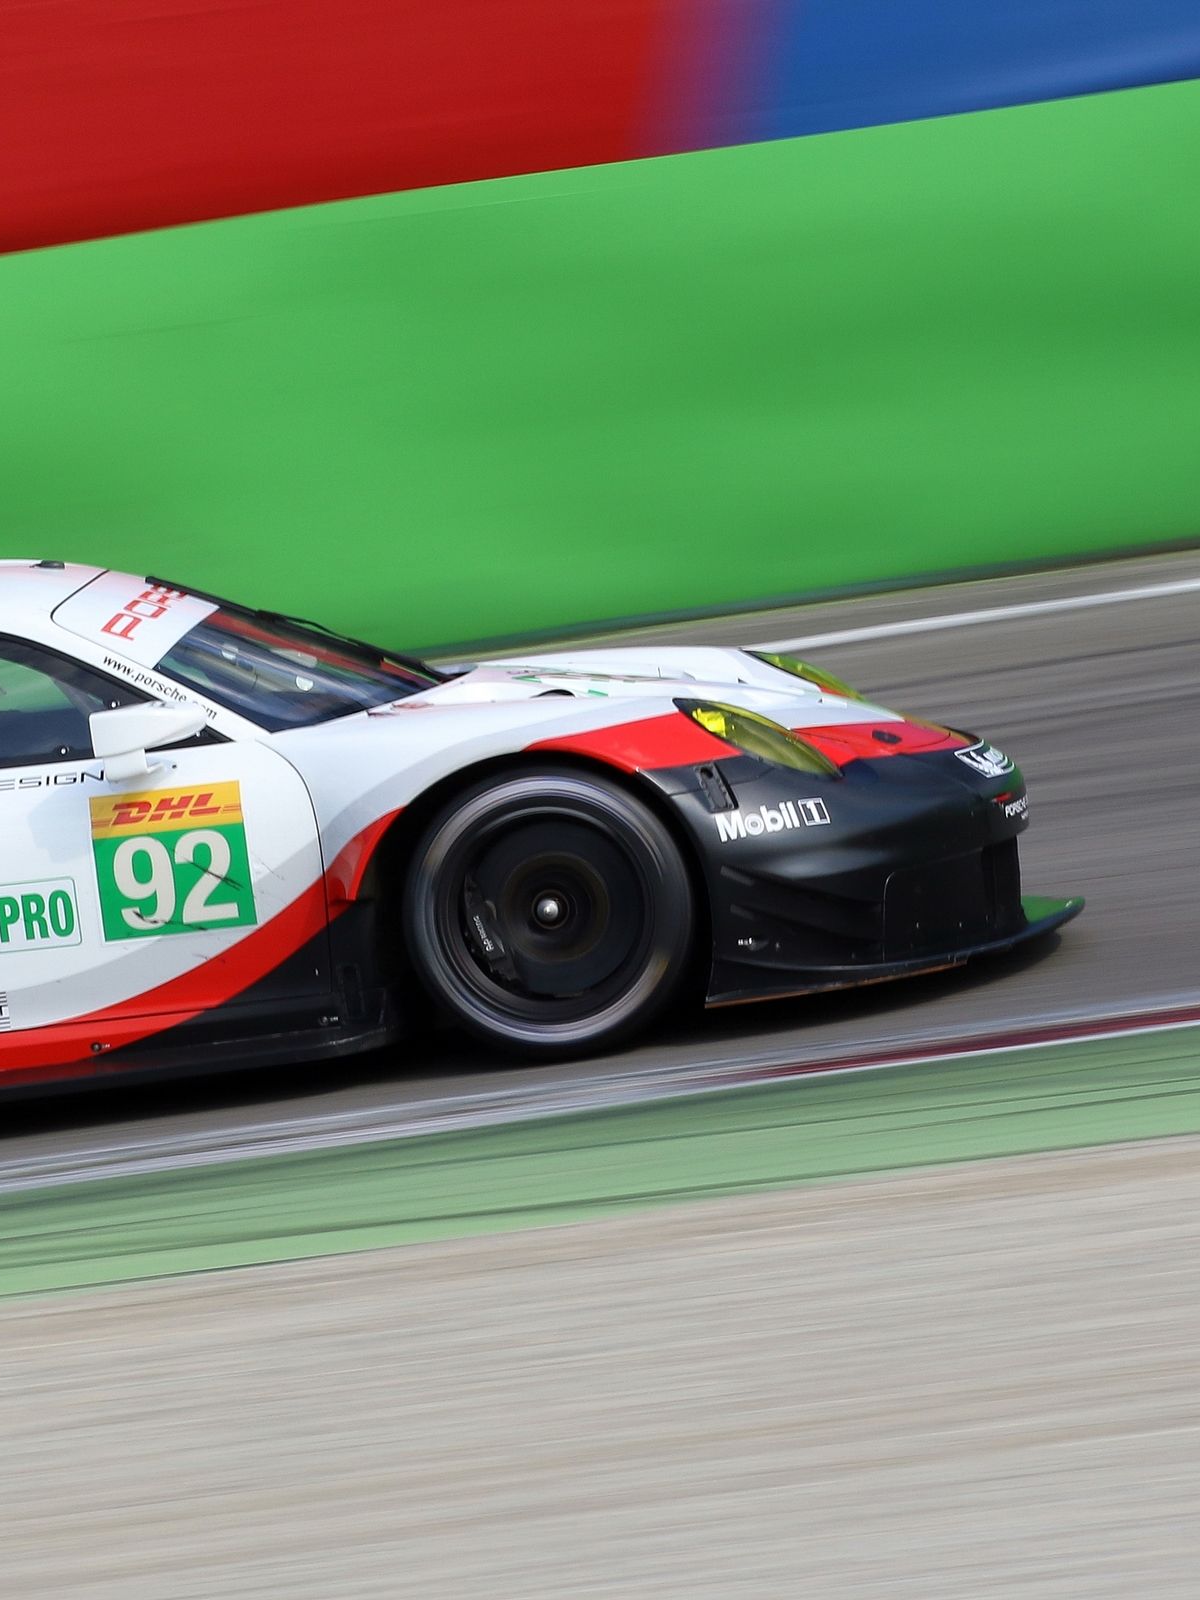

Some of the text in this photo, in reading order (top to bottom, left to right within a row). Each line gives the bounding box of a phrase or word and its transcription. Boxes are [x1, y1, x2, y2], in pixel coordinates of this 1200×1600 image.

[110, 792, 222, 827] DHL
[714, 801, 800, 843] Mobil
[112, 829, 241, 931] 92
